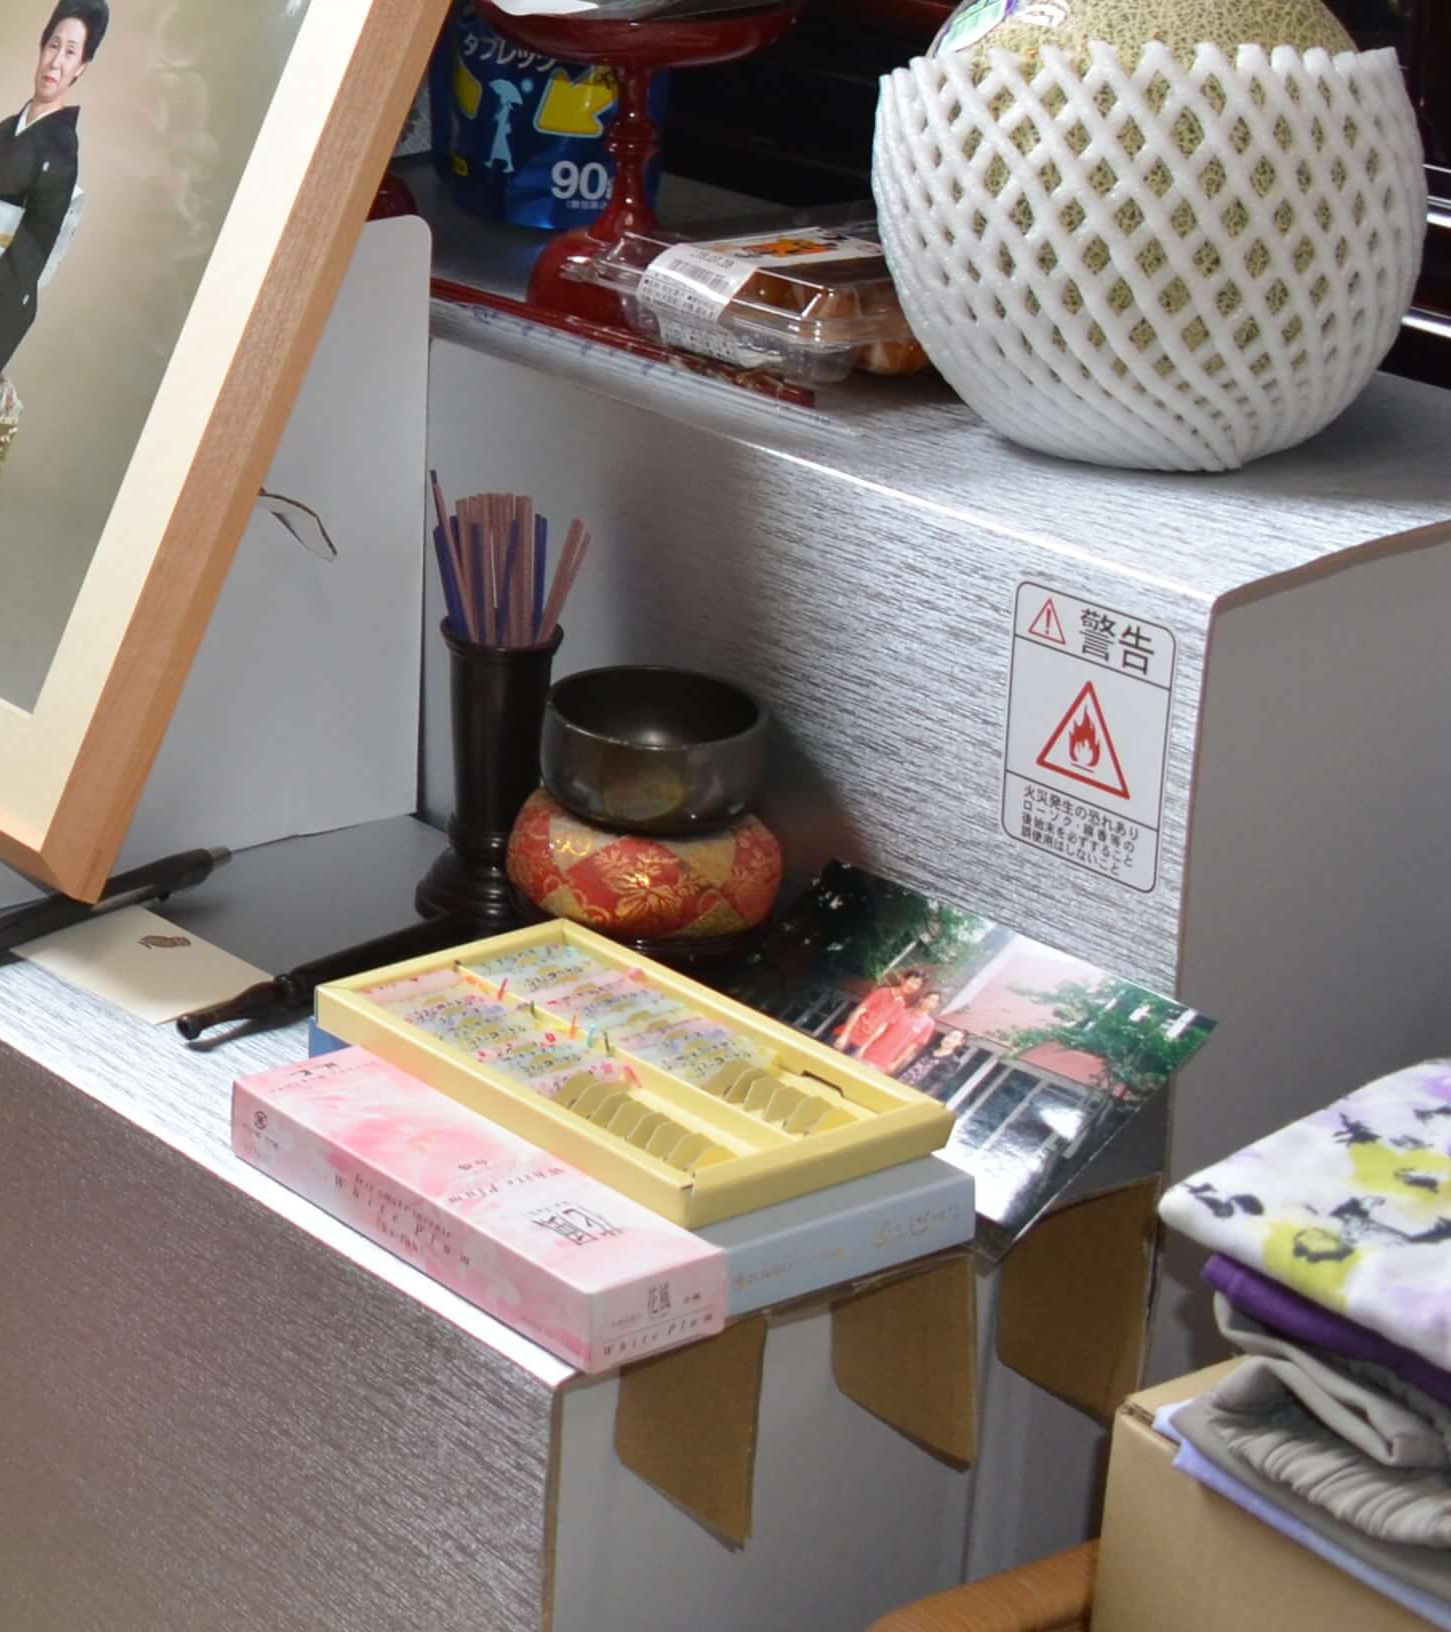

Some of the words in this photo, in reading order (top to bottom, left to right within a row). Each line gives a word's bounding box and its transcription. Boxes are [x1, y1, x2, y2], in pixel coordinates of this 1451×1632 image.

[1079, 607, 1155, 675] 警告
[1023, 784, 1139, 841] 火災発生の恐れあり
